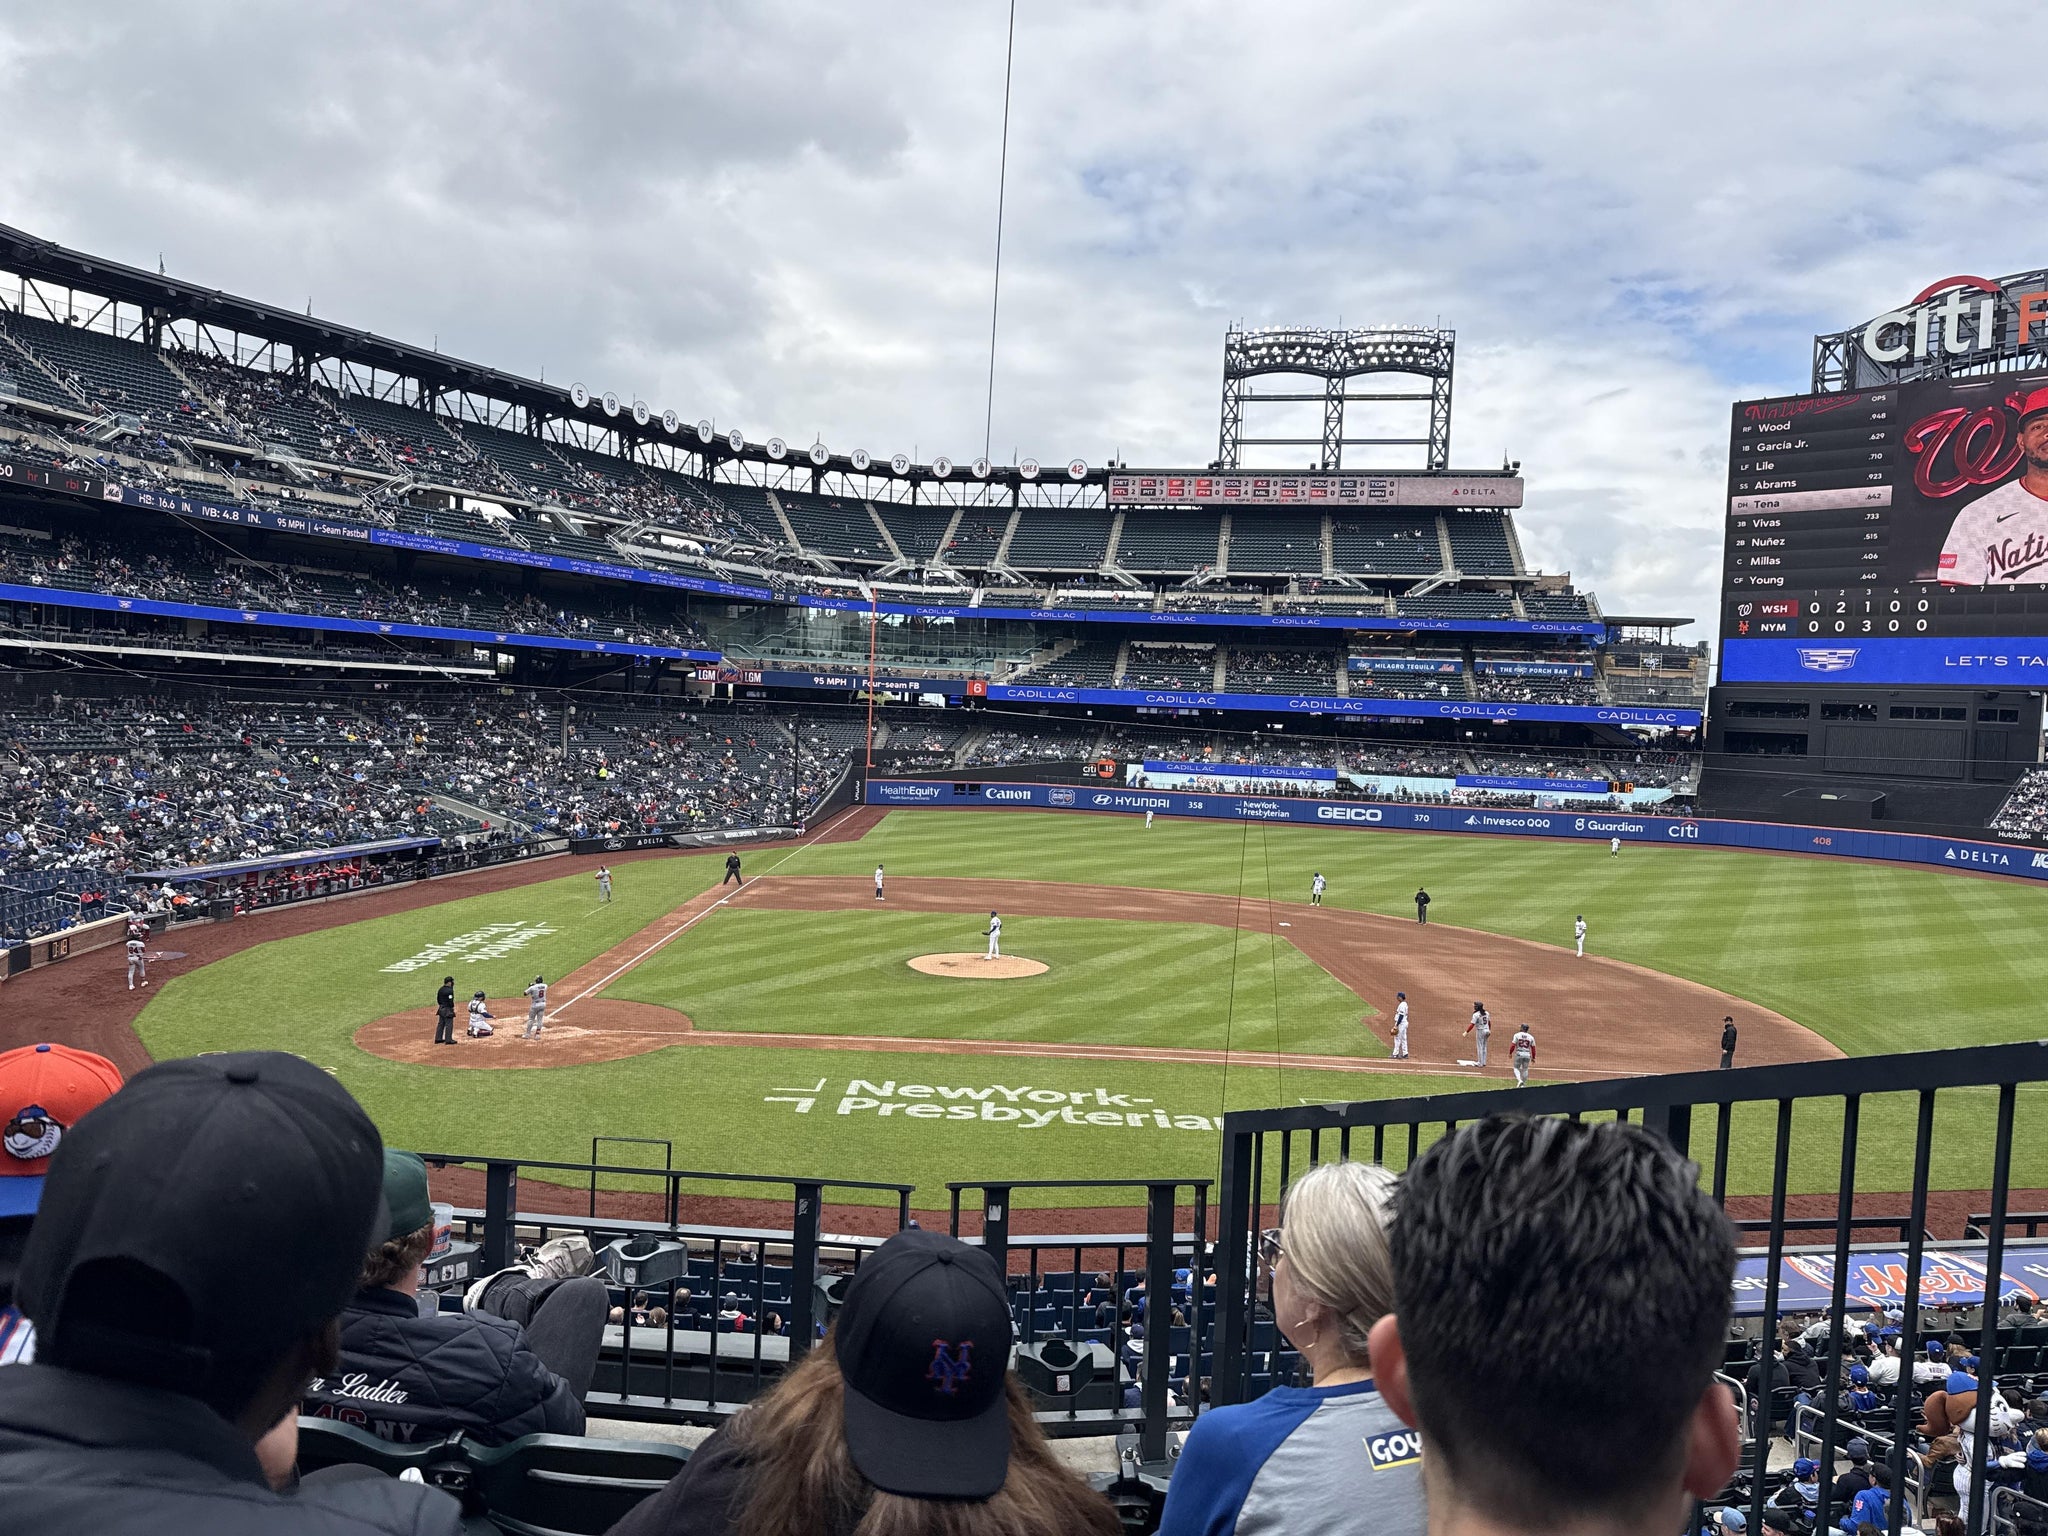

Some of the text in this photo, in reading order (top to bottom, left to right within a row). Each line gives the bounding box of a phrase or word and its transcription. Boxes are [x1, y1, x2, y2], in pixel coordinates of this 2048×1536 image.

[1864, 289, 1994, 362] citi
[577, 389, 583, 402] 5
[607, 398, 616, 410] 18
[638, 408, 646, 419] 16
[666, 415, 676, 428] 24
[1758, 420, 1791, 433] Wood
[702, 426, 710, 437] 17
[732, 436, 741, 446] 36
[1794, 440, 1809, 449] Jr.
[772, 444, 782, 454] 31
[814, 449, 824, 460] 41
[856, 454, 865, 464] 14
[895, 460, 906, 470] 37
[1022, 464, 1037, 473] SHEA
[1070, 464, 1084, 474] 42
[1756, 460, 1775, 471] Lile
[27, 469, 90, 492] hr 1 rbi 7
[1754, 479, 1797, 490] Abrams
[158, 496, 176, 510] 16.6
[181, 502, 193, 513] IN.
[222, 510, 240, 522] 4.8
[247, 513, 262, 524] IN.
[1754, 500, 1780, 509] Tena
[1752, 518, 1781, 528] Vivas
[277, 518, 368, 540] 95 MPH 4-Seam Fastball
[1750, 556, 1781, 566] Millas
[1750, 576, 1784, 586] Young
[810, 599, 848, 608] CADILLAC
[1762, 605, 1788, 614] WSH
[1809, 602, 1820, 614] 0
[1836, 602, 1846, 614] 2
[1864, 600, 1870, 612] 1
[1890, 600, 1900, 612] 0
[1918, 600, 1928, 612] 0
[1399, 620, 1450, 628] CADILLAC
[1760, 624, 1786, 632] NYM
[1808, 620, 1819, 632] 0
[1834, 620, 1845, 632] 0
[1862, 620, 1872, 632] 3
[1888, 620, 1900, 632] 0
[1916, 619, 1928, 631] 0
[1945, 656, 2008, 666] LET'S
[698, 670, 762, 682] LGM LGM
[826, 678, 847, 686] MPH
[902, 682, 920, 690] FB
[974, 683, 982, 694] 6
[1007, 690, 1075, 700] CADILLAC
[1146, 694, 1216, 705] CADILLAC
[1289, 700, 1364, 710] CADILLAC
[1440, 706, 1518, 716] CADILLAC
[1598, 710, 1677, 722] CADILLAC
[1166, 764, 1216, 772] CADILLAC
[1262, 768, 1312, 776] CADILLAC
[1475, 778, 1518, 786] CADILLAC
[1544, 782, 1588, 790] CADILLAC
[880, 785, 940, 798] HealthEquity
[986, 788, 1031, 800] Canon
[1115, 796, 1170, 808] HYUNDAI
[1243, 808, 1290, 818] Presbyterian
[1318, 806, 1382, 822] GEICO
[1414, 814, 1430, 822] 370
[1483, 816, 1550, 829] Invesco QQQ
[1588, 820, 1644, 833] Guardian
[1668, 823, 1699, 839] citi
[606, 838, 625, 850] Ford
[644, 837, 664, 846] DELTA
[1812, 836, 1832, 846] 408
[1960, 850, 2010, 866] DELTA
[538, 990, 544, 998] 8
[1518, 1039, 1530, 1048] 23
[846, 1078, 1154, 1106] NewYork-
[1859, 1264, 1987, 1298] Mets
[925, 1338, 975, 1394] NY
[332, 1373, 409, 1404] Ladder
